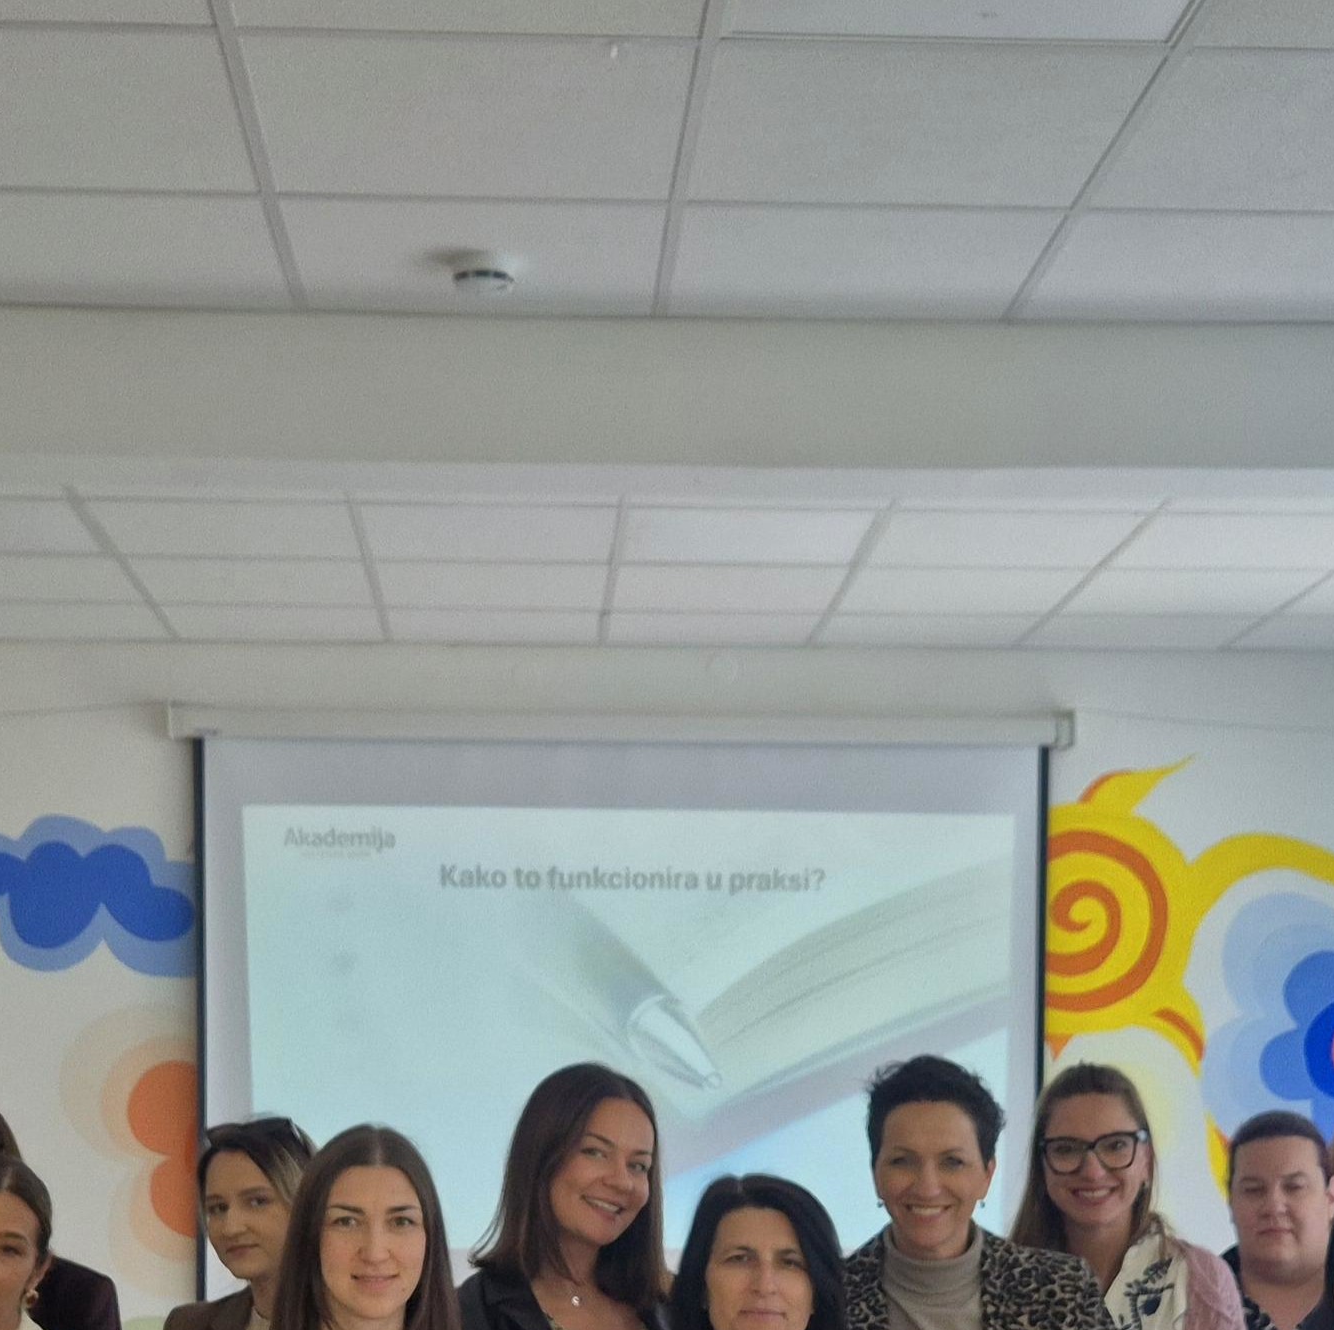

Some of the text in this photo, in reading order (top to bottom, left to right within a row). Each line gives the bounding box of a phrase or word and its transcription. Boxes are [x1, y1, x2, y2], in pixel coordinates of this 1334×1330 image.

[283, 825, 396, 853] Akademija
[440, 864, 827, 896] Kako to funkcionira u praksi?
